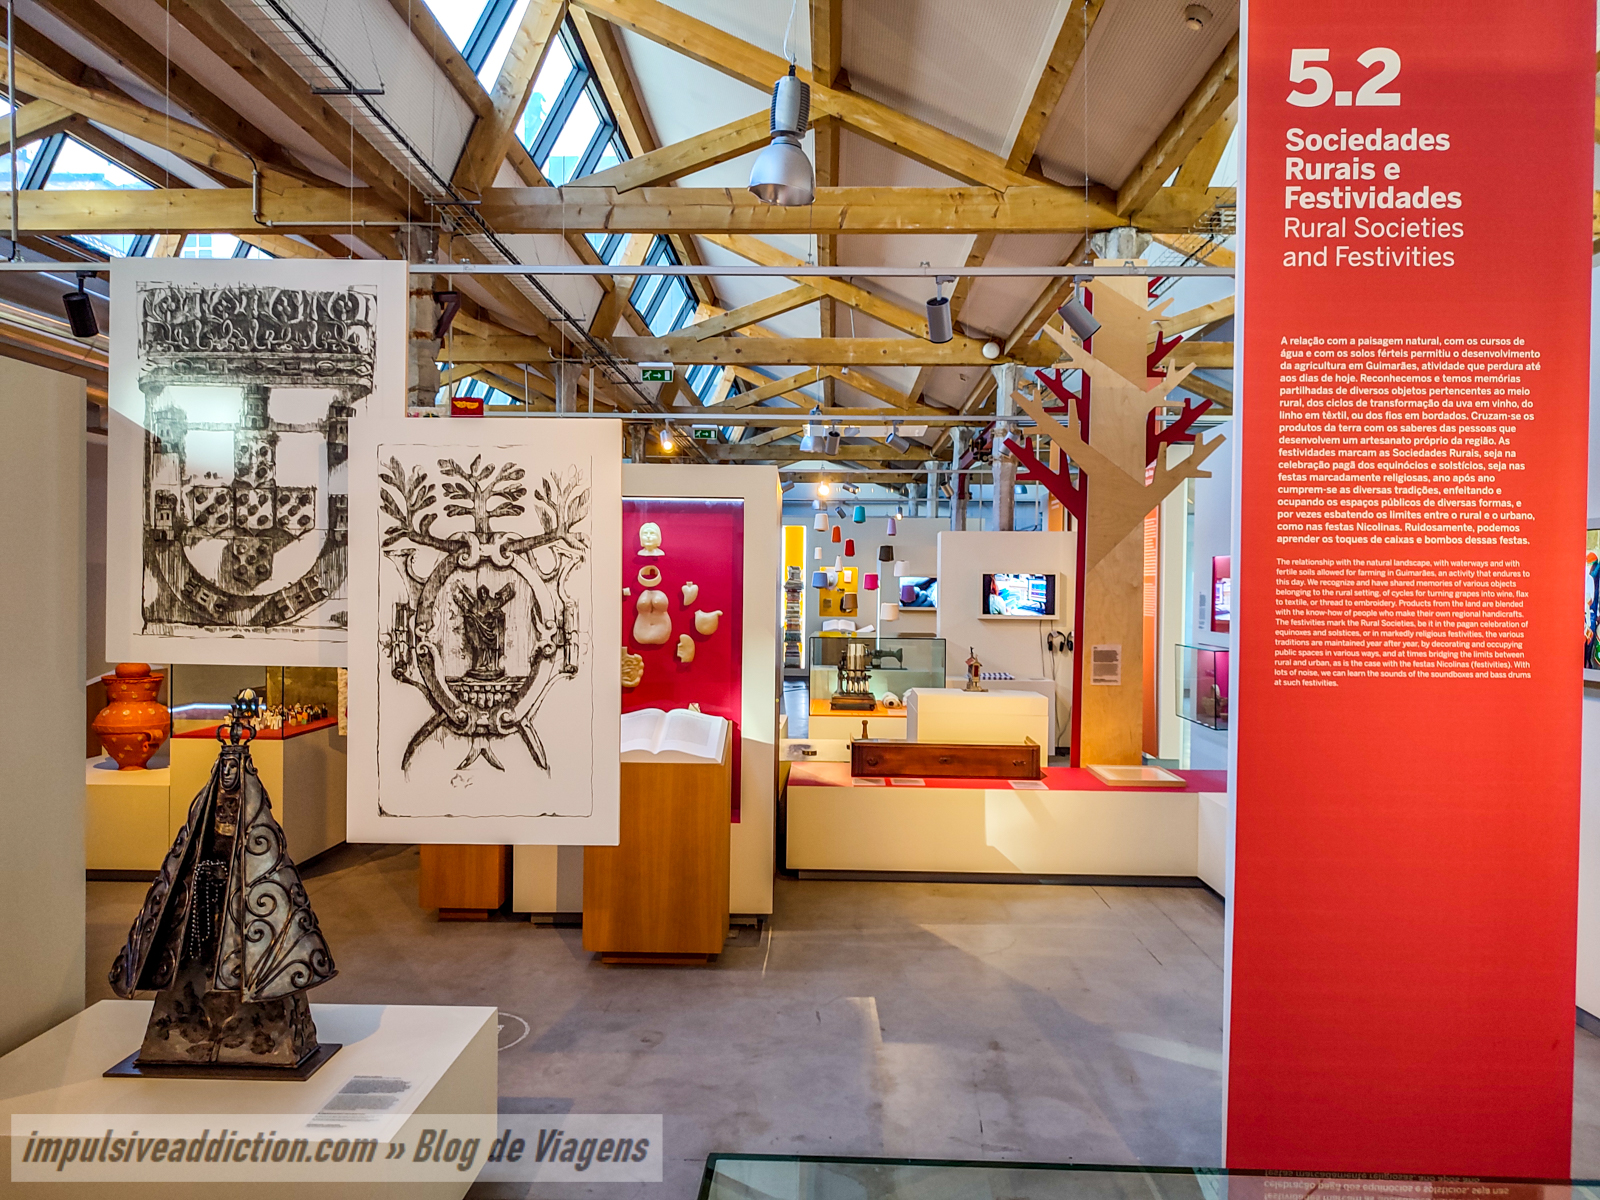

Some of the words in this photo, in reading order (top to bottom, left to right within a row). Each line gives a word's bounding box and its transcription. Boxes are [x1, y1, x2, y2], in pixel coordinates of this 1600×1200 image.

[1286, 47, 1401, 107] 5.2
[1285, 128, 1451, 151] Sociedades
[1285, 157, 1376, 180] Rurais
[1384, 163, 1401, 180] e
[1284, 186, 1463, 209] Festividades
[1284, 217, 1346, 238] Rural
[1354, 217, 1464, 238] Societies
[1283, 246, 1327, 267] and
[1336, 246, 1455, 267] Festivities
[1281, 336, 1288, 345] A
[1290, 336, 1325, 347] relação
[1358, 336, 1404, 347] paisagem
[1406, 336, 1442, 346] natural,
[1513, 336, 1525, 345] de
[1280, 348, 1304, 359] água
[1350, 349, 1375, 357] solos
[1378, 349, 1408, 357] férteis
[1411, 349, 1451, 360] permitiu
[1462, 349, 1540, 358] desenvolvimento
[1280, 361, 1292, 370] da
[1294, 361, 1346, 372] agricultura
[1422, 361, 1465, 370] atividade
[1467, 364, 1485, 372] que
[1488, 361, 1524, 372] perdura
[1526, 361, 1541, 370] até
[1299, 373, 1319, 382] dias
[1321, 373, 1333, 382] de
[1335, 373, 1358, 384] hoje.
[1360, 373, 1432, 382] Reconhecemos
[1474, 373, 1521, 382] memórias
[1280, 386, 1334, 397] partilhadas
[1336, 386, 1348, 395] de
[1350, 386, 1390, 395] diversos
[1392, 386, 1427, 397] objetos
[1429, 387, 1492, 397] pertencentes
[1508, 386, 1530, 395] meio
[1280, 398, 1304, 408] rural,
[1306, 398, 1324, 407] dos
[1326, 398, 1354, 407] ciclos
[1356, 398, 1368, 407] de
[1370, 398, 1440, 409] transformação
[1442, 398, 1454, 407] da
[1492, 398, 1520, 408] vinho,
[1521, 398, 1534, 407] do
[1280, 410, 1303, 419] linho
[1366, 411, 1383, 419] dos
[1385, 411, 1402, 419] fios
[1422, 411, 1469, 420] bordados.
[1471, 411, 1522, 420] Cruzam-se
[1279, 423, 1322, 434] produtos
[1324, 423, 1336, 432] da
[1400, 423, 1437, 432] saberes
[1439, 423, 1456, 432] das
[1459, 426, 1497, 434] pessoas
[1499, 426, 1516, 434] que
[1279, 435, 1340, 444] desenvolvem
[1414, 436, 1449, 447] próprio
[1451, 436, 1463, 445] da
[1498, 436, 1510, 445] As
[1278, 447, 1336, 456] festividades
[1392, 448, 1447, 457] Sociedades
[1450, 448, 1482, 458] Rurais,
[1484, 449, 1502, 460] seja
[1278, 460, 1330, 471] celebração
[1332, 460, 1356, 471] pagã
[1358, 460, 1375, 469] dos
[1377, 460, 1429, 472] equinócios
[1488, 461, 1507, 472] seja
[1278, 472, 1307, 481] festas
[1310, 472, 1381, 481] marcadamente
[1383, 473, 1431, 484] religiosas,
[1452, 473, 1476, 484] após
[1278, 487, 1338, 496] cumprem-se
[1353, 485, 1392, 494] diversas
[1443, 485, 1494, 494] enfeitando
[1292, 558, 1335, 567] relationship
[1450, 560, 1489, 569] waterways
[1358, 568, 1386, 578] farming
[1448, 569, 1475, 578] activity
[1320, 578, 1355, 588] recognize
[1490, 580, 1516, 589] objects
